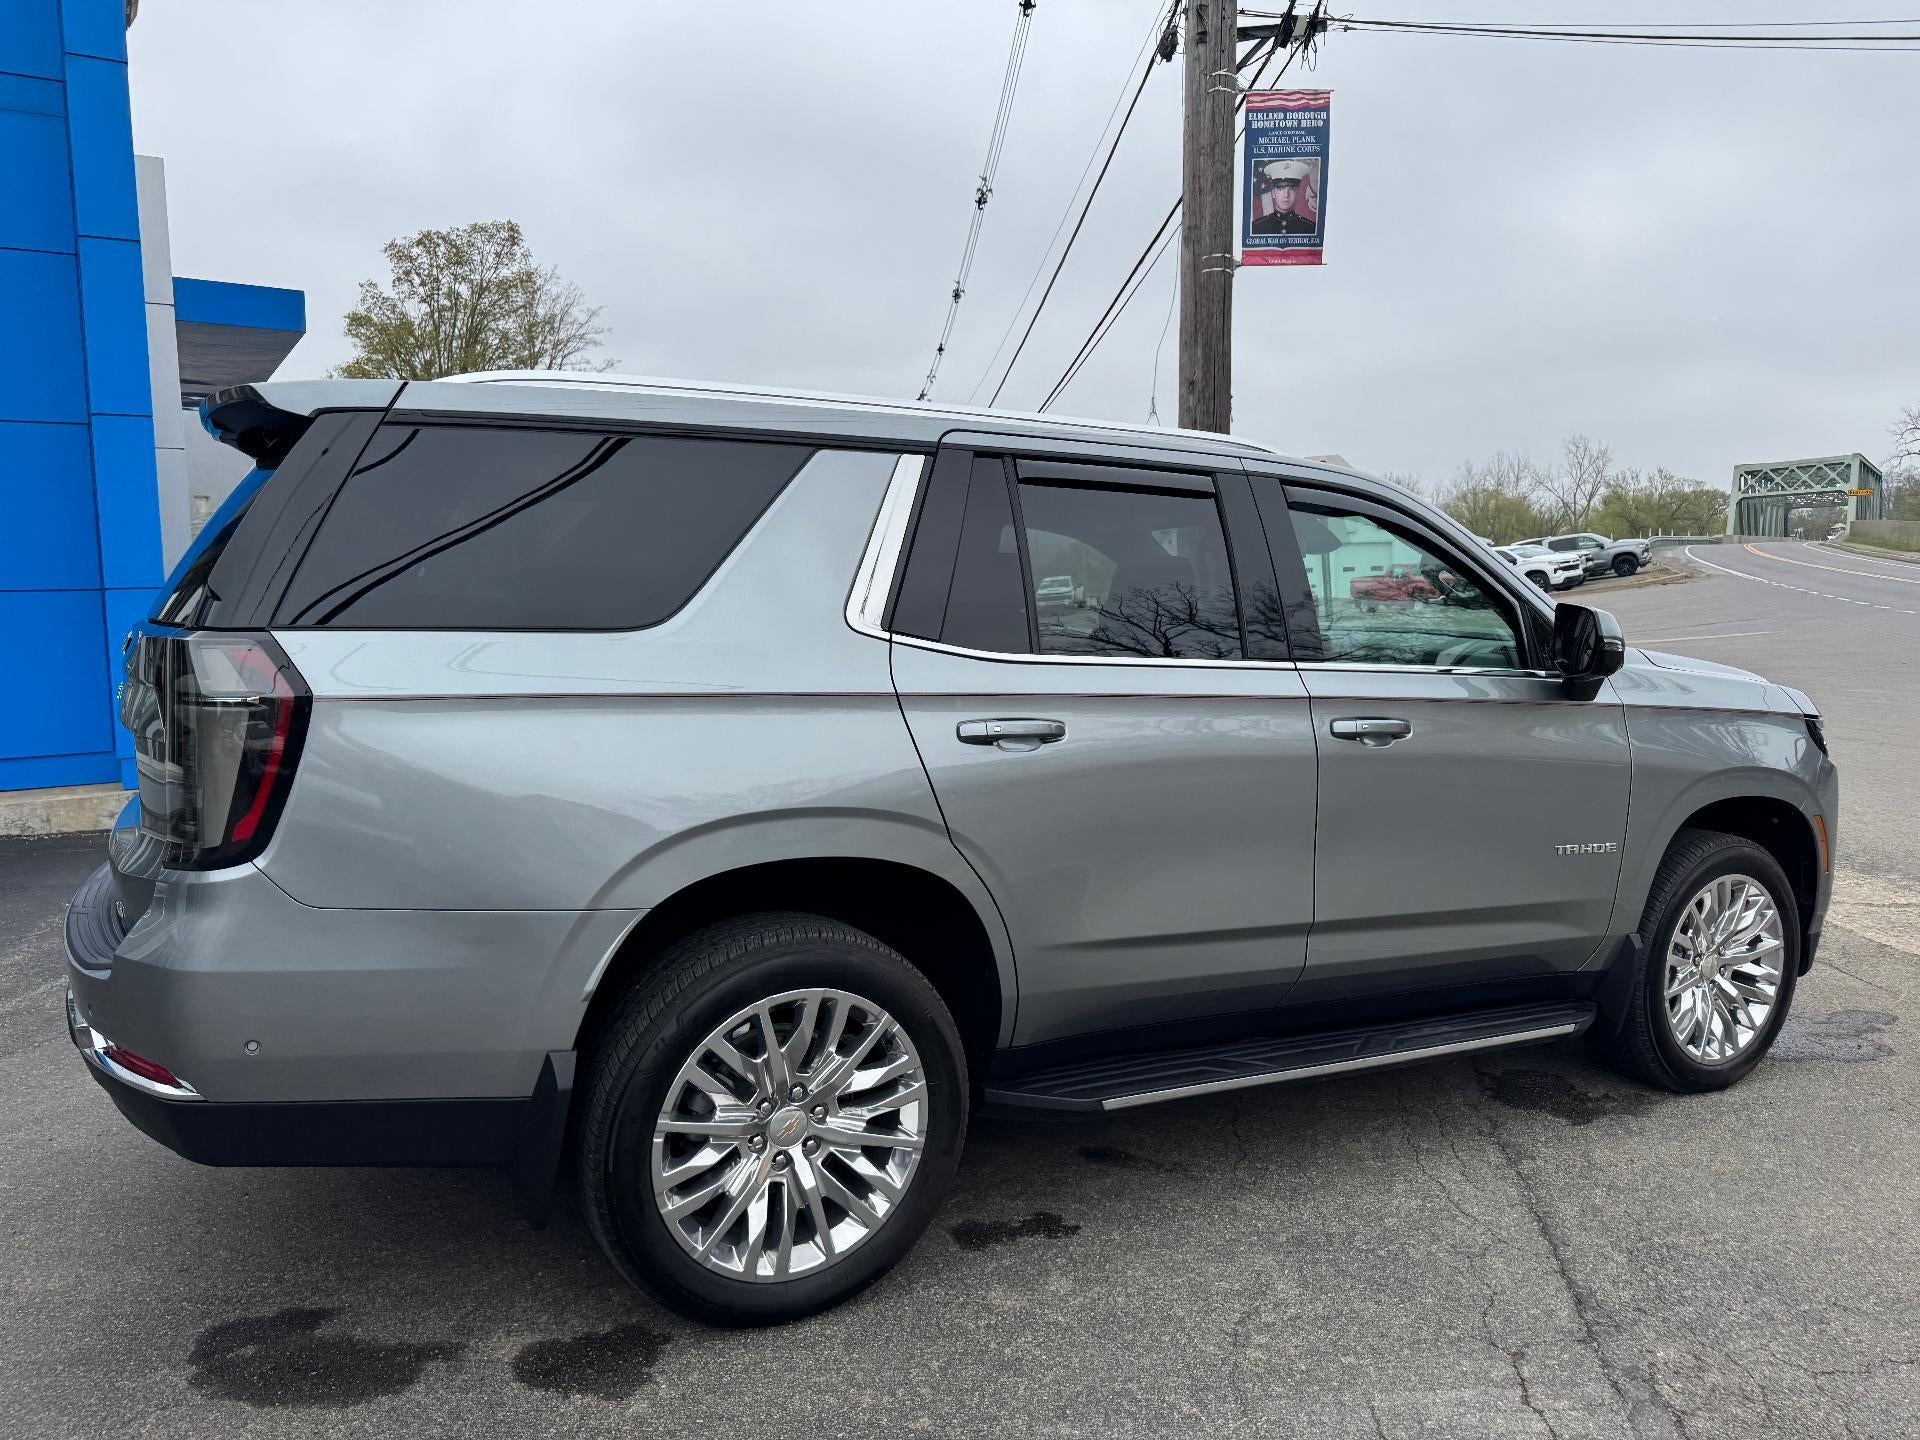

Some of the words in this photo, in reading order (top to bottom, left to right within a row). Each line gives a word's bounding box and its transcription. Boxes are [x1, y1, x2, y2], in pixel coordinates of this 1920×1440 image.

[1248, 112, 1284, 121] ELKLAND
[1286, 111, 1327, 120] BOROUGH
[1251, 120, 1298, 129] HOMETOWN
[1300, 119, 1324, 128] HERO
[1258, 136, 1291, 144] MICHAEL
[1292, 135, 1316, 143] PLANK
[1267, 146, 1296, 154] MARINE
[1297, 145, 1321, 153] CORPS
[1246, 237, 1267, 245] GLOBAL
[1267, 237, 1279, 245] WAR
[1554, 842, 1617, 855] TAHOE
